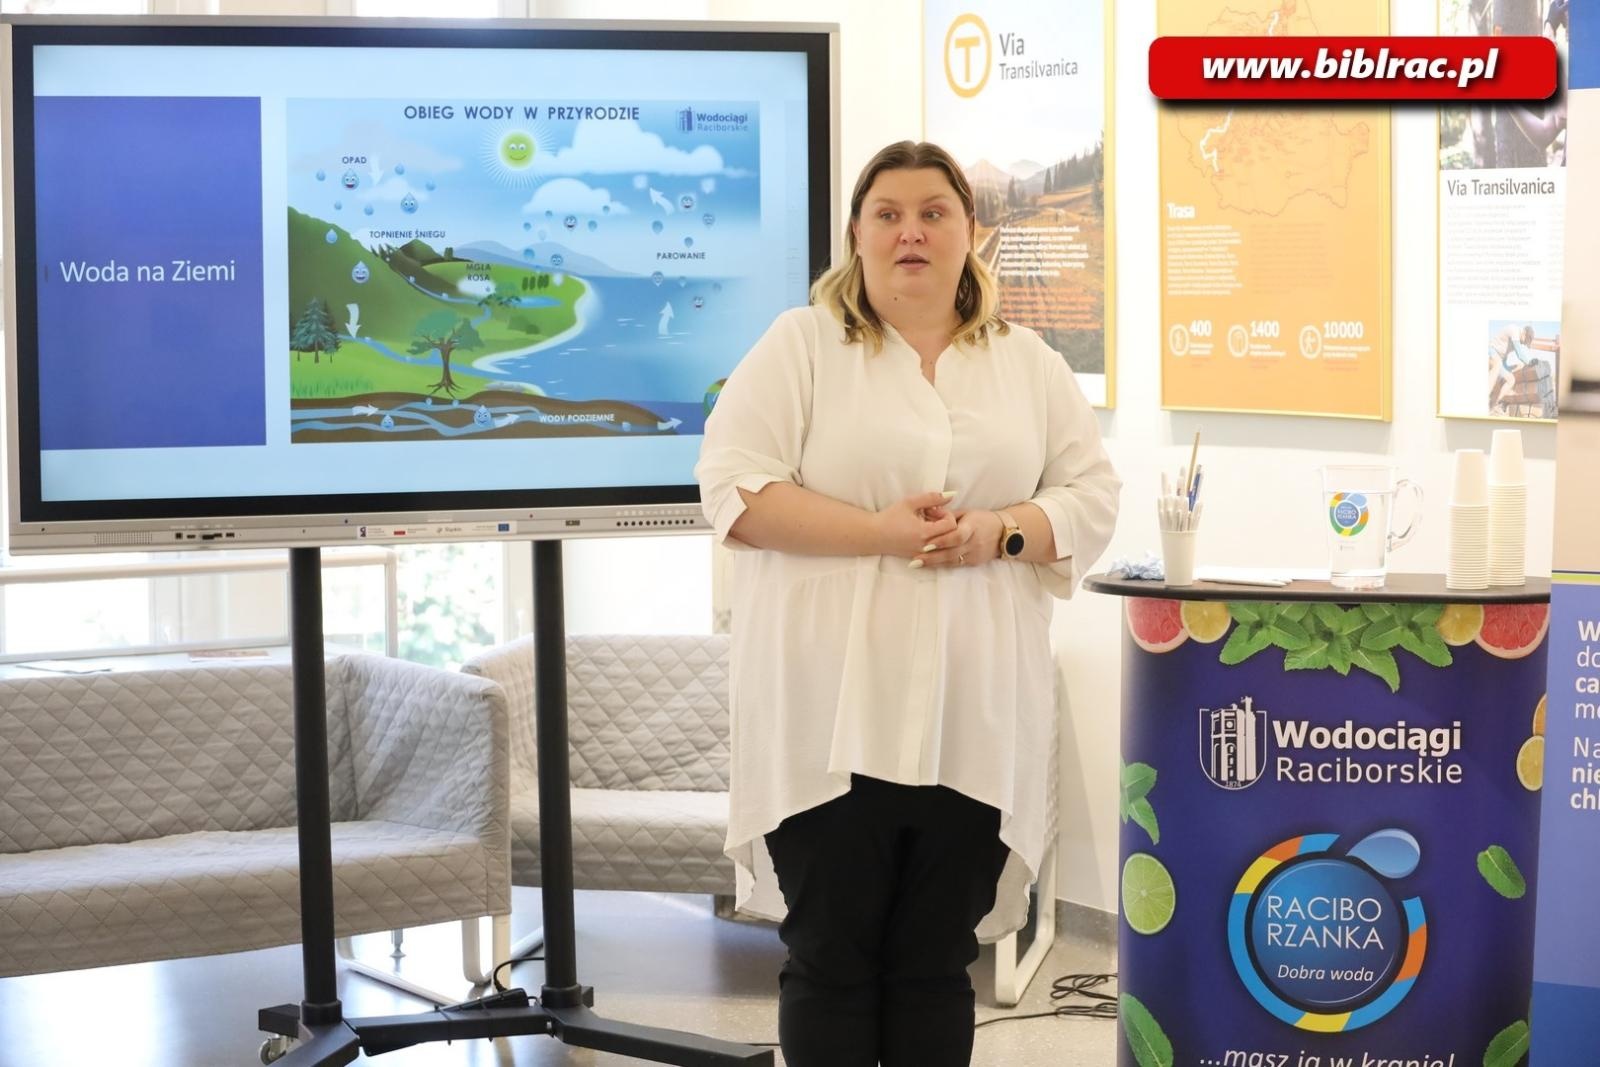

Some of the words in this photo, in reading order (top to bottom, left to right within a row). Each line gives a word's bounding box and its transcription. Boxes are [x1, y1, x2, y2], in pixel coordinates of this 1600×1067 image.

[999, 32, 1025, 57] Via
[999, 58, 1079, 80] Transilvanica
[404, 105, 455, 120] OBIEG
[464, 105, 514, 120] WODY
[524, 105, 538, 120] W
[548, 106, 640, 121] PRZYRODZIE
[697, 113, 748, 124] Wodociągi
[697, 123, 748, 132] Raciborskie
[342, 155, 367, 165] OPAD
[1447, 179, 1468, 196] Via
[1471, 177, 1556, 196] Transilvanica
[1167, 202, 1196, 219] Trasa
[369, 230, 413, 239] TOPNIENIE
[415, 228, 446, 238] ŚNIEGU
[656, 251, 706, 261] PAROWANIE
[60, 260, 129, 282] Woda
[136, 265, 165, 281] na
[171, 258, 237, 281] Ziemi
[1190, 320, 1212, 336] 400
[1250, 321, 1279, 337] 1400
[539, 415, 565, 423] WODY
[567, 413, 615, 422] PODZIEMNE
[1272, 720, 1462, 757] Wodociągi
[1276, 757, 1463, 784] Raciborskie
[1266, 895, 1382, 923] RACIBO
[1266, 923, 1384, 951] RZANKA
[1277, 964, 1325, 981] Dobra
[1329, 966, 1374, 983] woda
